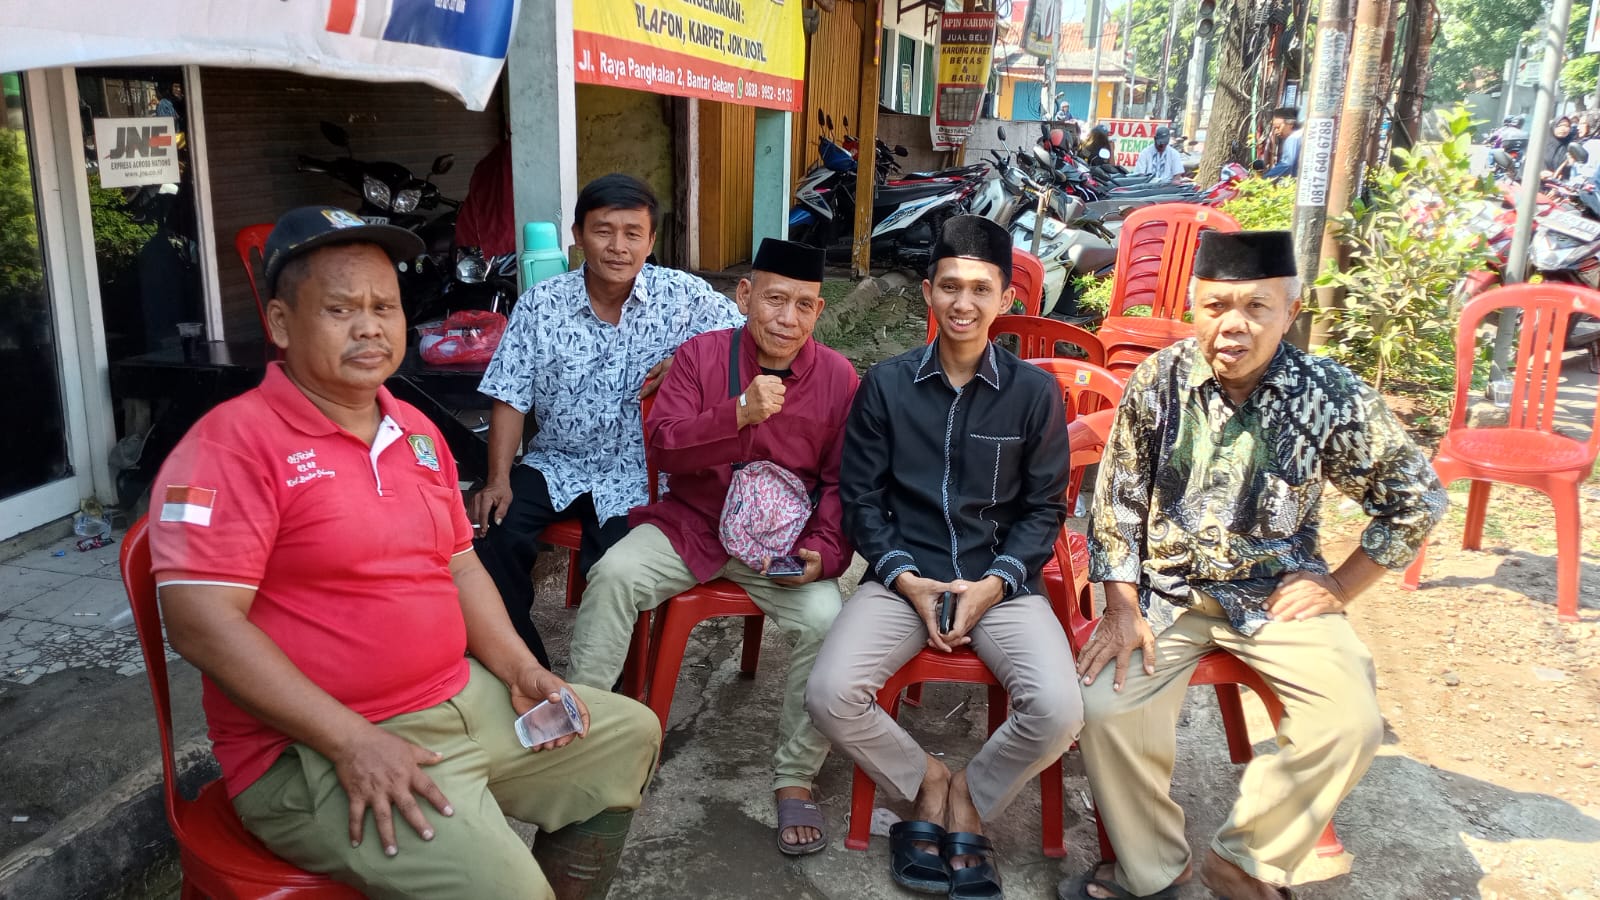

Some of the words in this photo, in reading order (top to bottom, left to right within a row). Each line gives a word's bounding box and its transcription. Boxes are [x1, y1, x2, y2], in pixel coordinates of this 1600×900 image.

[944, 19, 961, 28] APIN
[963, 18, 993, 28] KARUNG
[635, 4, 686, 45] PLAFON,
[689, 20, 726, 56] KARPET,
[728, 34, 743, 57] JOK
[947, 34, 967, 42] JUAL
[969, 34, 988, 42] BELI
[942, 46, 969, 54] KARUNG
[970, 46, 990, 54] PAKET
[949, 57, 982, 65] BEKAS
[578, 49, 595, 72] Jl.
[600, 51, 626, 80] Raya
[628, 57, 675, 85] Pangkalan
[677, 67, 685, 89] 2,
[687, 70, 710, 90] Bantar
[712, 75, 734, 98] Gebang
[961, 65, 968, 74] &
[951, 74, 978, 82] BARU
[1317, 121, 1332, 148] 6788
[110, 125, 171, 159] JNE
[111, 161, 132, 170] EXPRESS
[133, 160, 150, 168] ACROSS
[152, 158, 171, 167] NATIONS
[1314, 152, 1328, 173] 640
[1311, 177, 1326, 203] 0817
